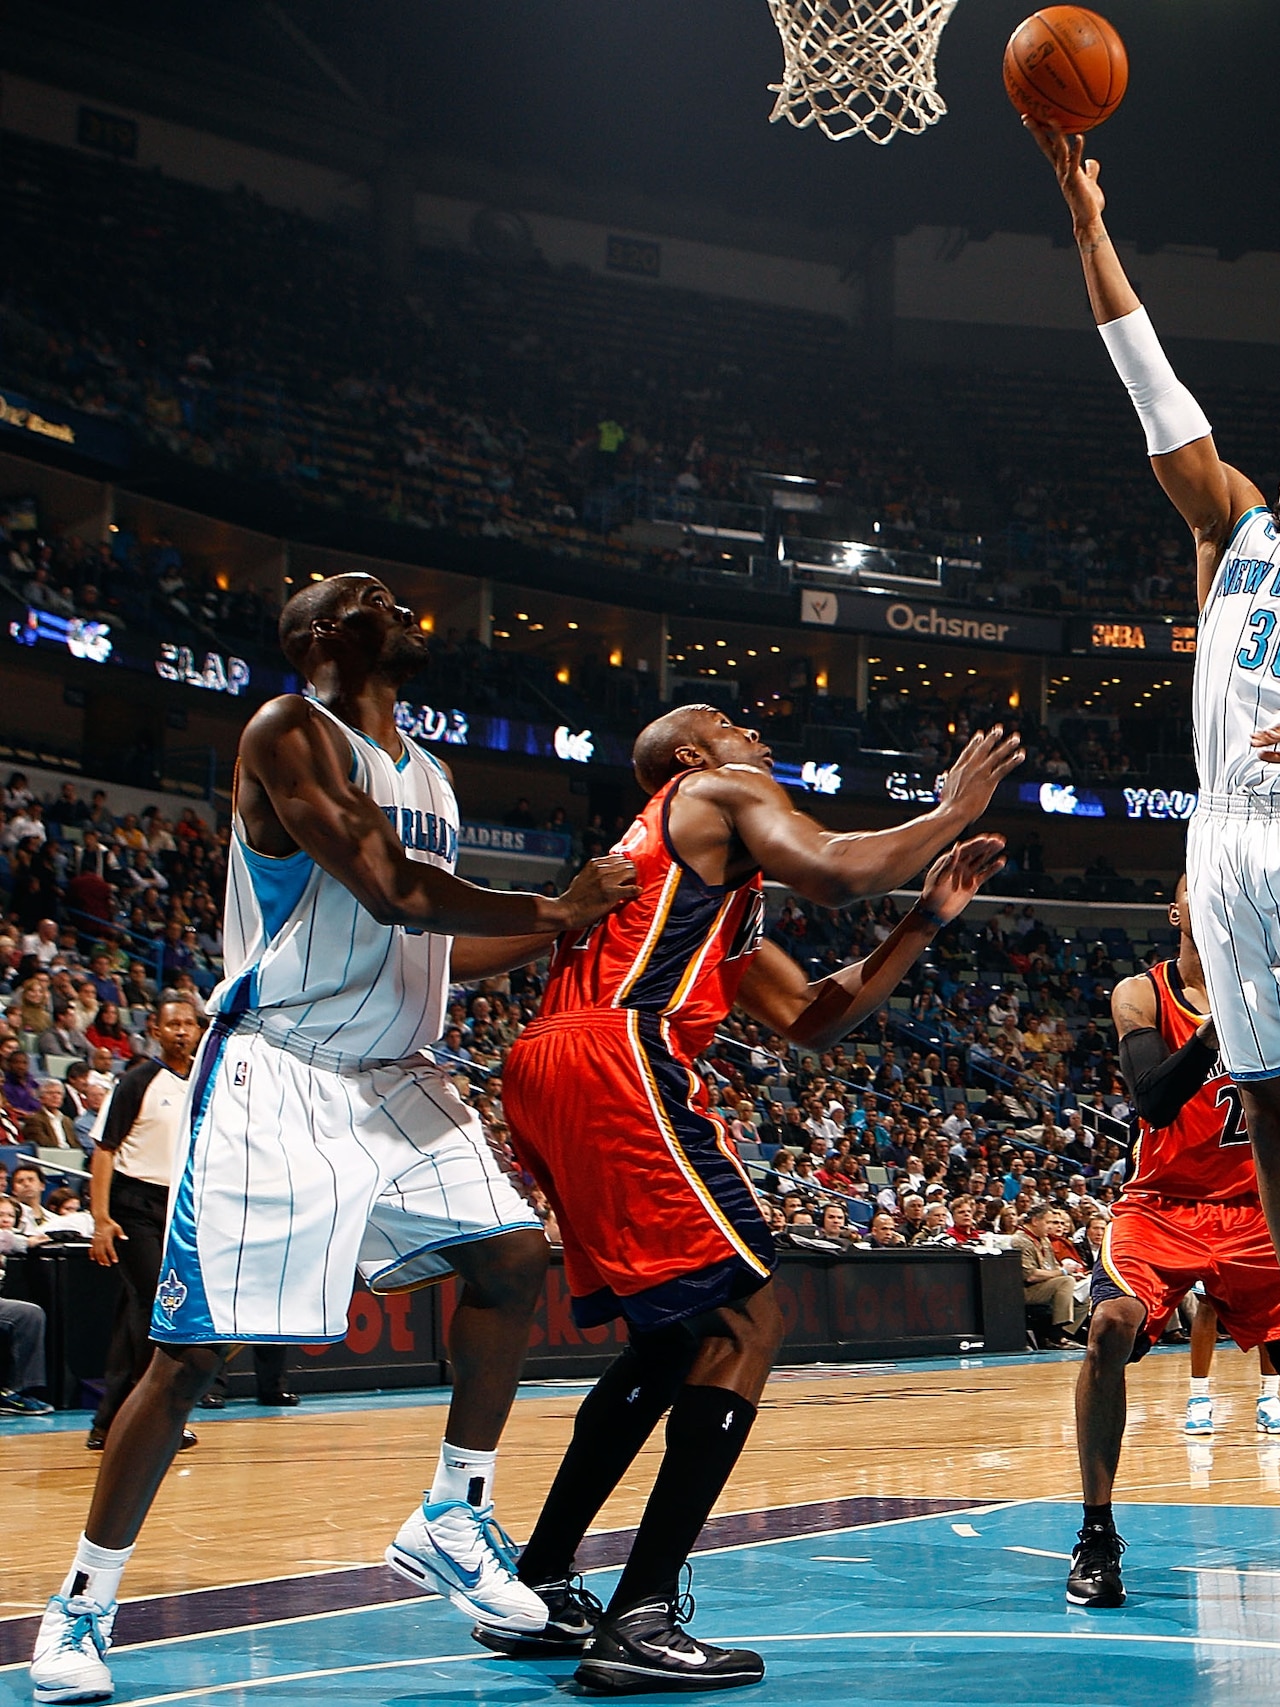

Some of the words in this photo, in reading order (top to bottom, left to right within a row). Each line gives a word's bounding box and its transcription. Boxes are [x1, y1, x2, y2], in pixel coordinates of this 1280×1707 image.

[1218, 559, 1274, 598] NEW
[886, 603, 1009, 641] Ochsner
[460, 826, 526, 850] EADERS
[775, 1271, 821, 1337] ot
[832, 1265, 968, 1333] Locker
